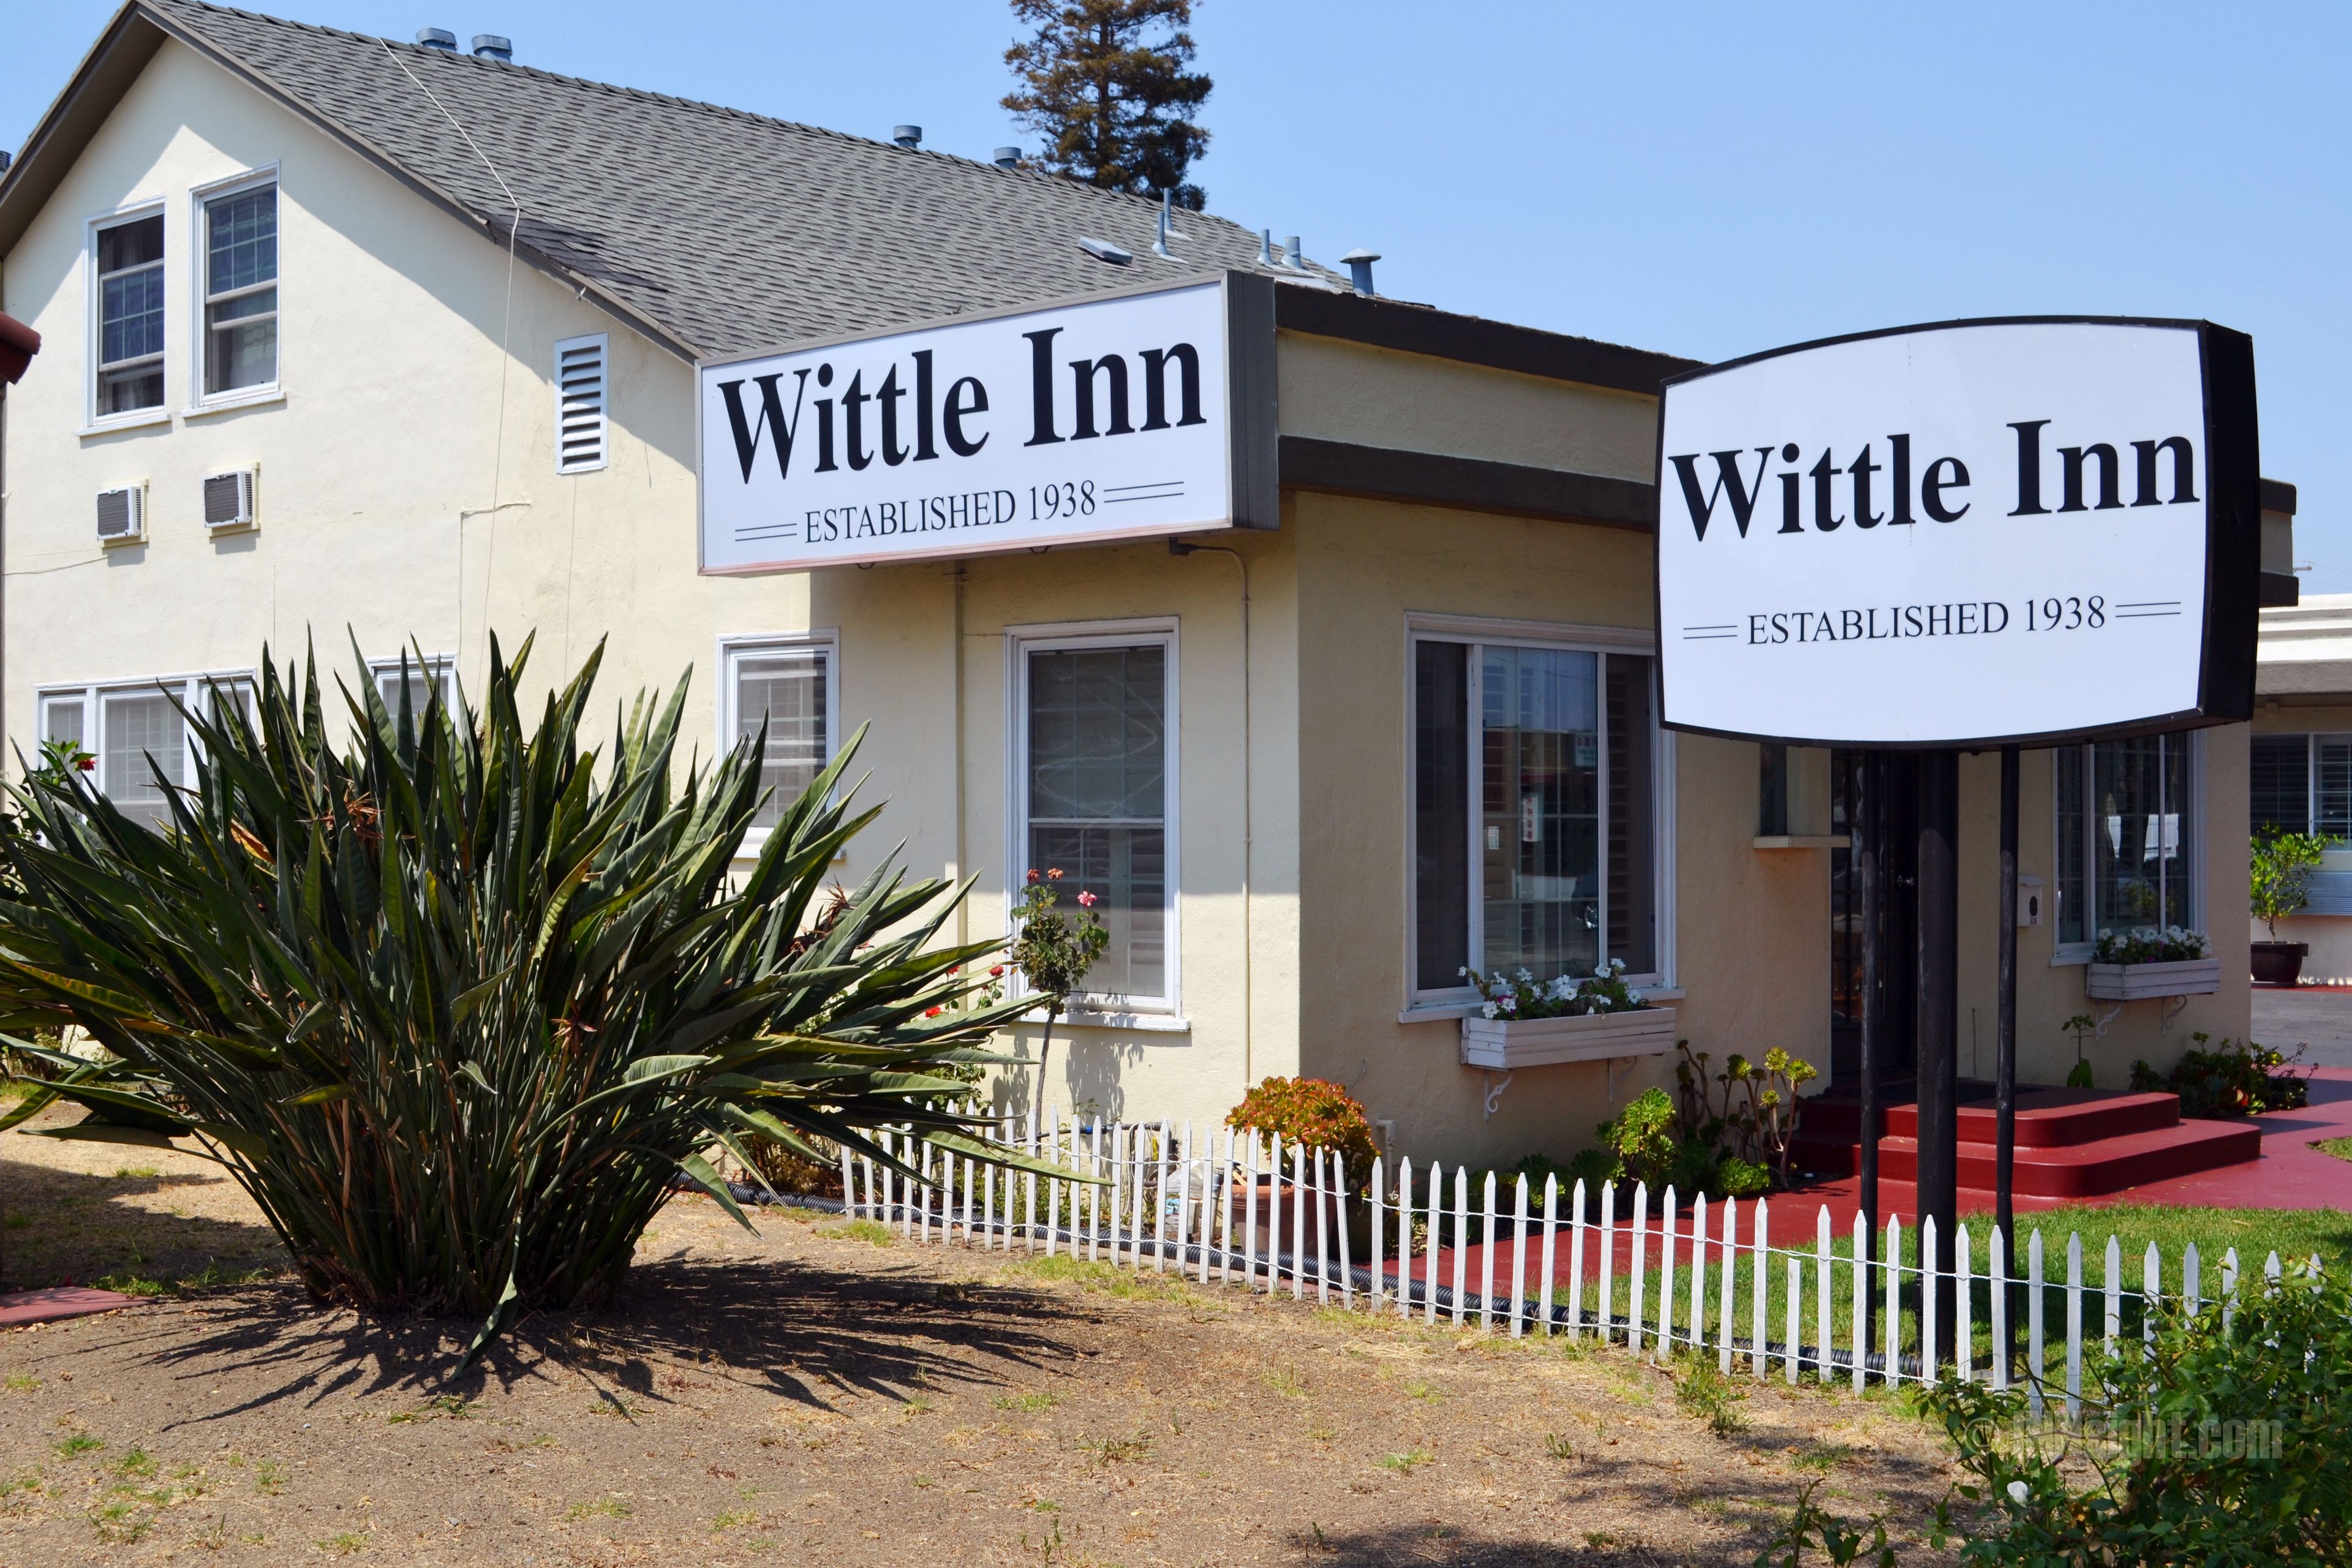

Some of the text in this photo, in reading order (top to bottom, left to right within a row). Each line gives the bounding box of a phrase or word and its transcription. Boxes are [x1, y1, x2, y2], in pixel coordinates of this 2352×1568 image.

[717, 326, 1207, 484] Wittle Inn
[805, 480, 1096, 543] ESTABLISHED 1938
[1667, 419, 2200, 542] Wittle Inn
[1748, 595, 2105, 644] ESTABLISHED 1938
